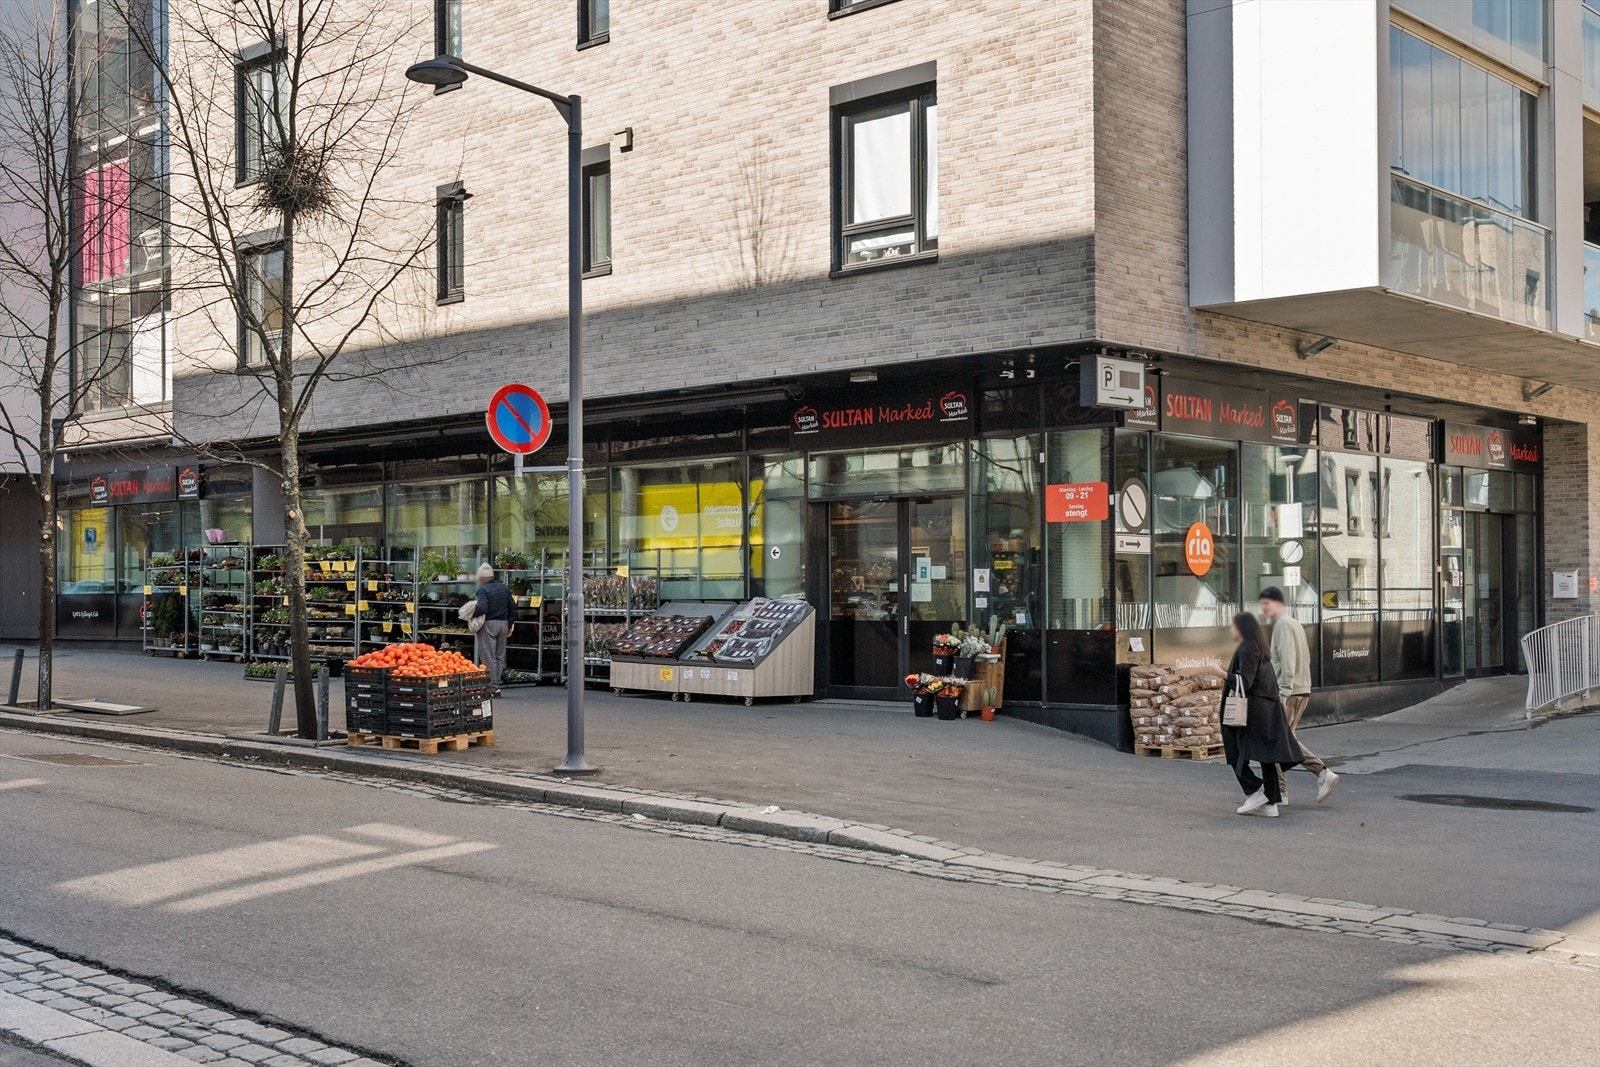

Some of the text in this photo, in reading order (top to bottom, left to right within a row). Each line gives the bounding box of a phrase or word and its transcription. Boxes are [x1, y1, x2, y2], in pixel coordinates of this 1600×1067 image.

[1105, 371, 1113, 387] P
[944, 401, 963, 410] SULTAN
[1166, 394, 1265, 427] SULTAN Marked
[823, 401, 935, 429] SULTAN Marked
[948, 407, 968, 417] Marked
[1136, 407, 1157, 418] Marked
[798, 415, 814, 423] SULTAN
[1276, 413, 1292, 423] SULTAN
[801, 421, 819, 430] Marked
[1451, 436, 1539, 462] SULTAN Marked
[110, 477, 171, 496] SULTAN Marked
[1065, 492, 1074, 500] 09
[1080, 491, 1088, 499] 21
[1065, 509, 1088, 518] stengt
[1189, 529, 1210, 556] ria
